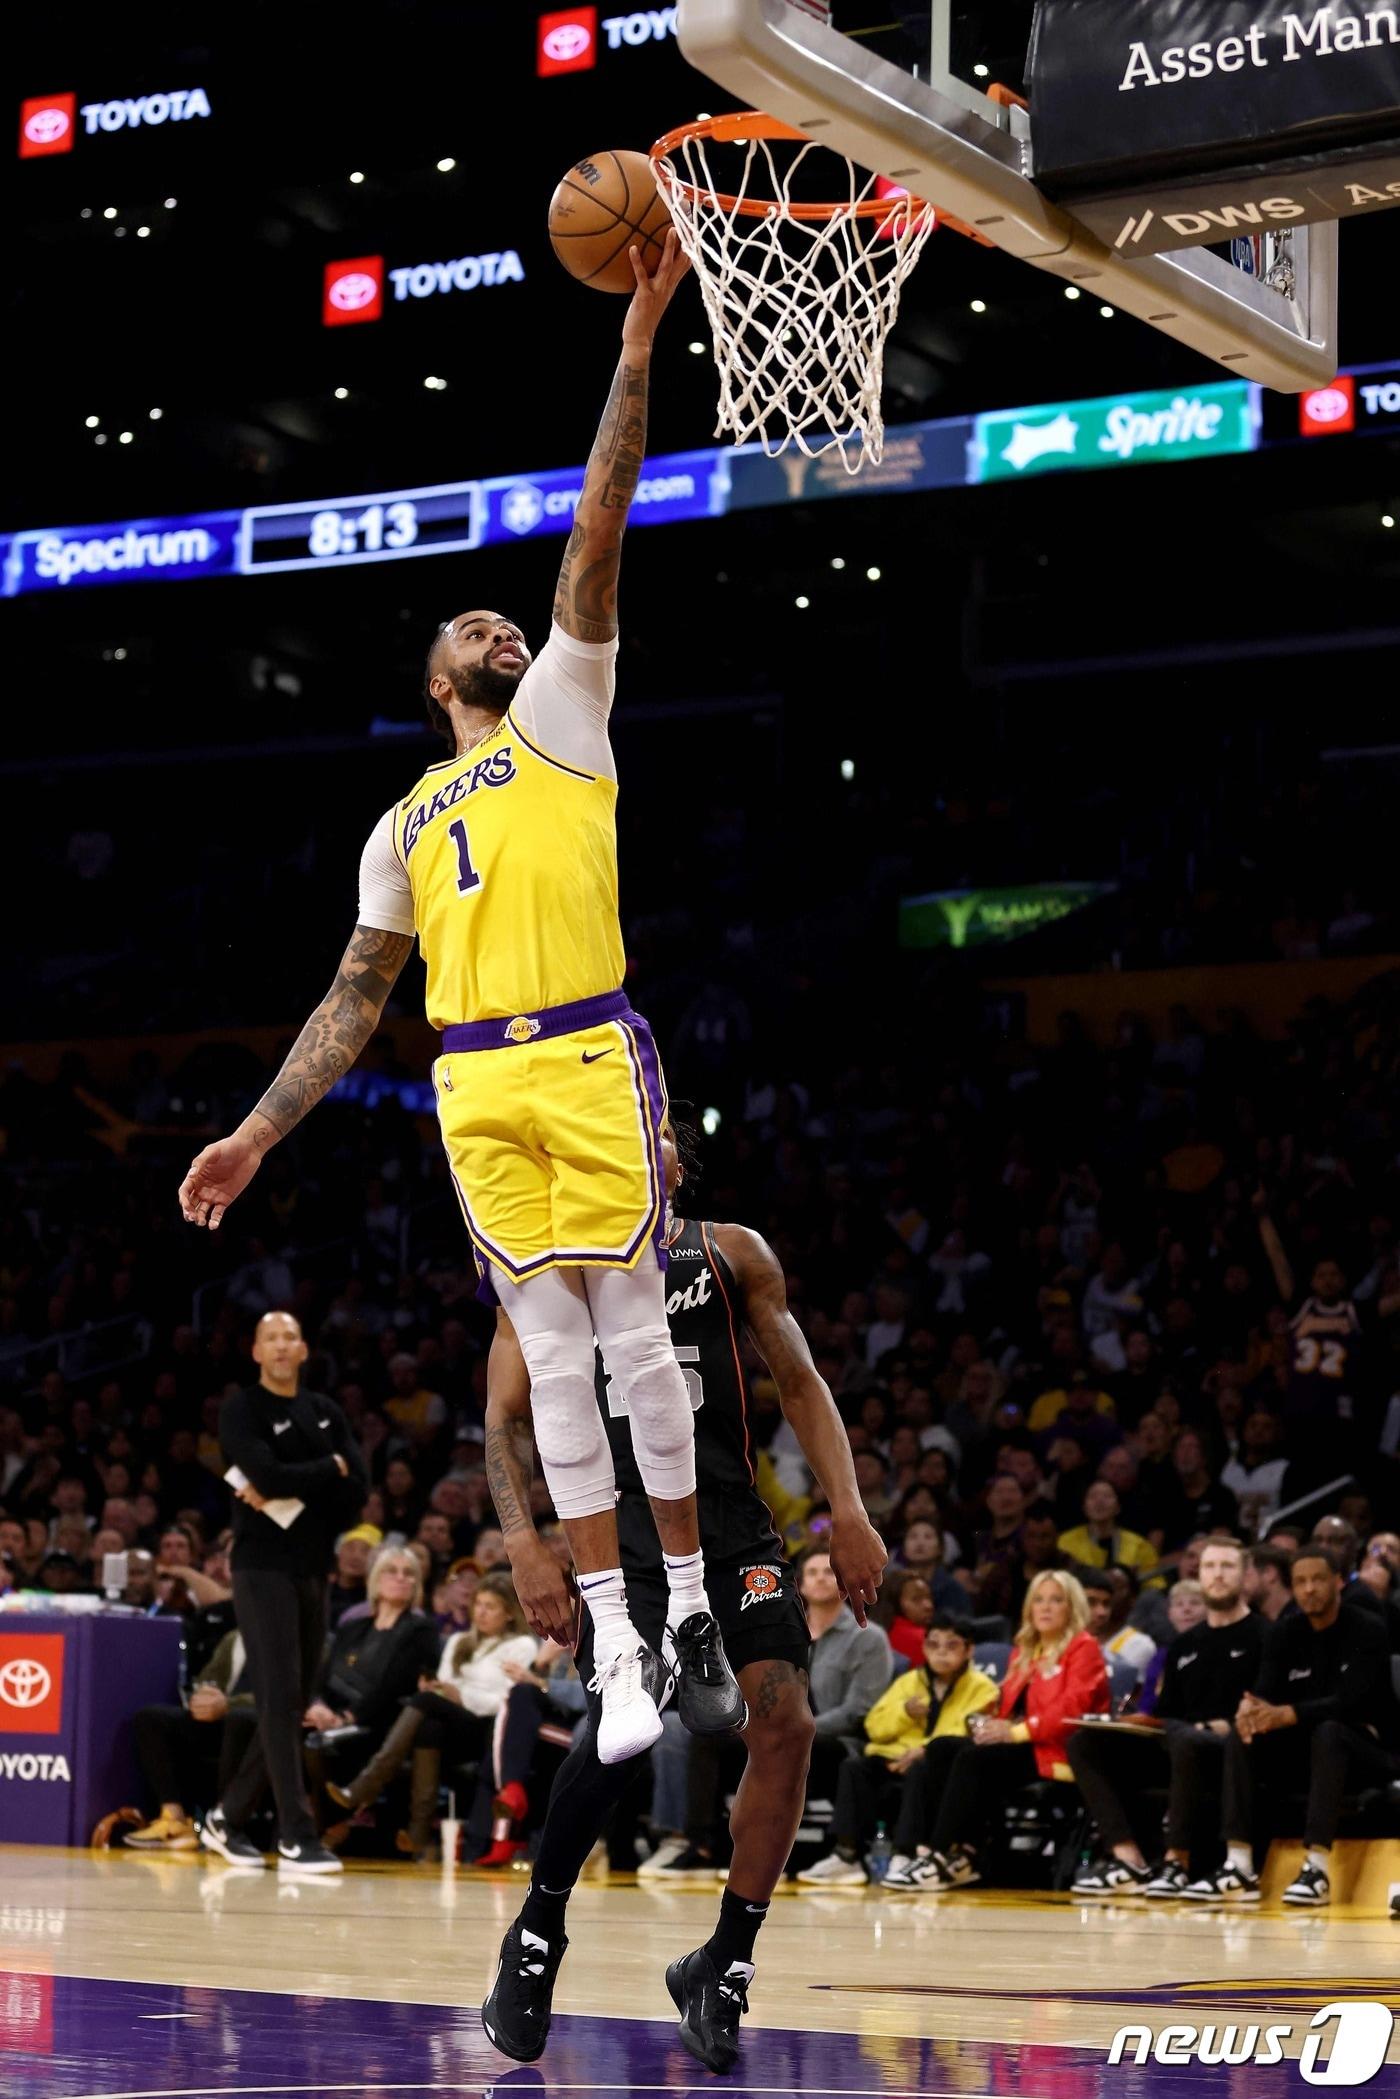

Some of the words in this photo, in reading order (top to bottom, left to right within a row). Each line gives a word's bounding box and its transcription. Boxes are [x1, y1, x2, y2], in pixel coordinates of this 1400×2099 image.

[1118, 23, 1269, 91] Asset
[1282, 7, 1400, 62] Man
[80, 88, 211, 134] TOYOTA
[1162, 197, 1305, 236] DWS
[388, 249, 526, 301] TOYOTA
[1359, 382, 1400, 415] TO
[1098, 397, 1223, 458] Sprite
[309, 502, 418, 557] 8:13
[35, 528, 211, 585] Spectrum
[403, 747, 516, 864] LAKERS
[448, 818, 483, 896] 1
[505, 1019, 541, 1039] LAKERS
[668, 1248, 704, 1259] UWM
[1294, 1338, 1347, 1378] 32
[740, 1588, 783, 1612] Detroit
[0, 1753, 72, 1782] YOTA
